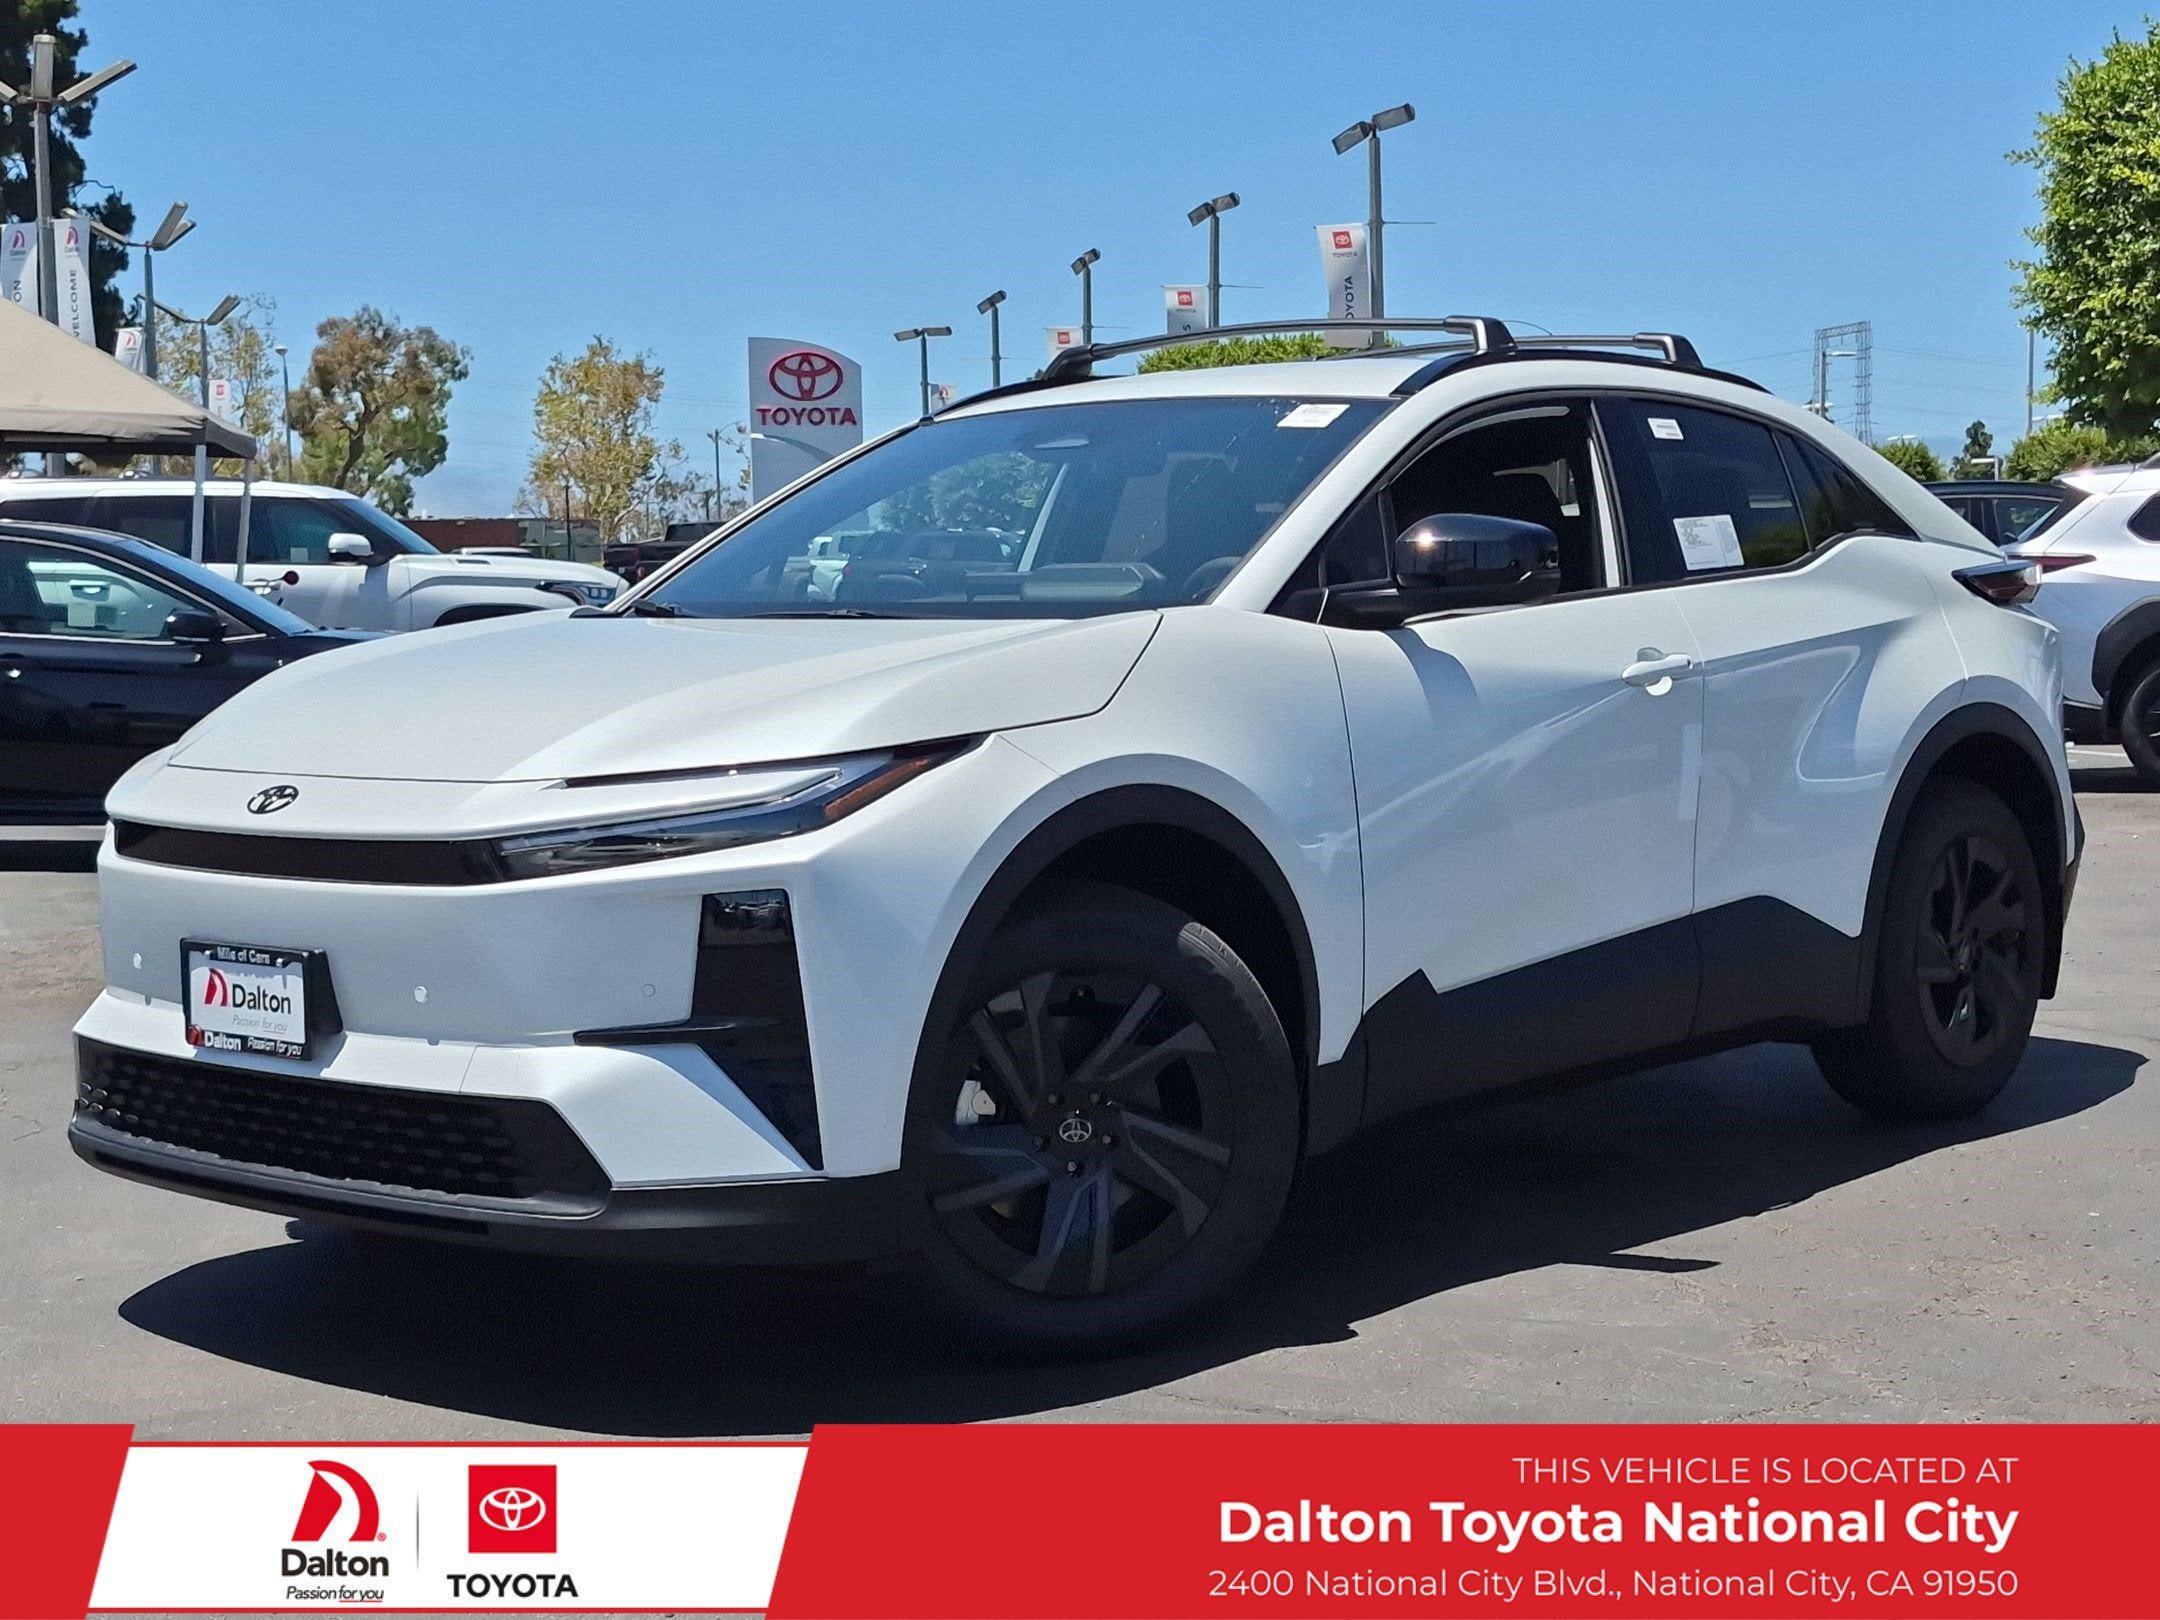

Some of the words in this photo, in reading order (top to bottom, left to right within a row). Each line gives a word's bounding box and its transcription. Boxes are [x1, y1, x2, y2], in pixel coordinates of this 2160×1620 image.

[1344, 276, 1355, 320] OYOTA
[756, 407, 858, 426] TOYOTA
[217, 946, 236, 961] Mile
[238, 949, 247, 962] of
[249, 950, 270, 964] Cars
[232, 983, 291, 1015] Dalton
[232, 1014, 260, 1028] Passion
[262, 1017, 273, 1030] for
[274, 1023, 288, 1032] you
[204, 1031, 241, 1051] Dalton
[247, 1037, 275, 1051] Passion
[276, 1040, 287, 1054] for
[287, 1045, 303, 1057] you
